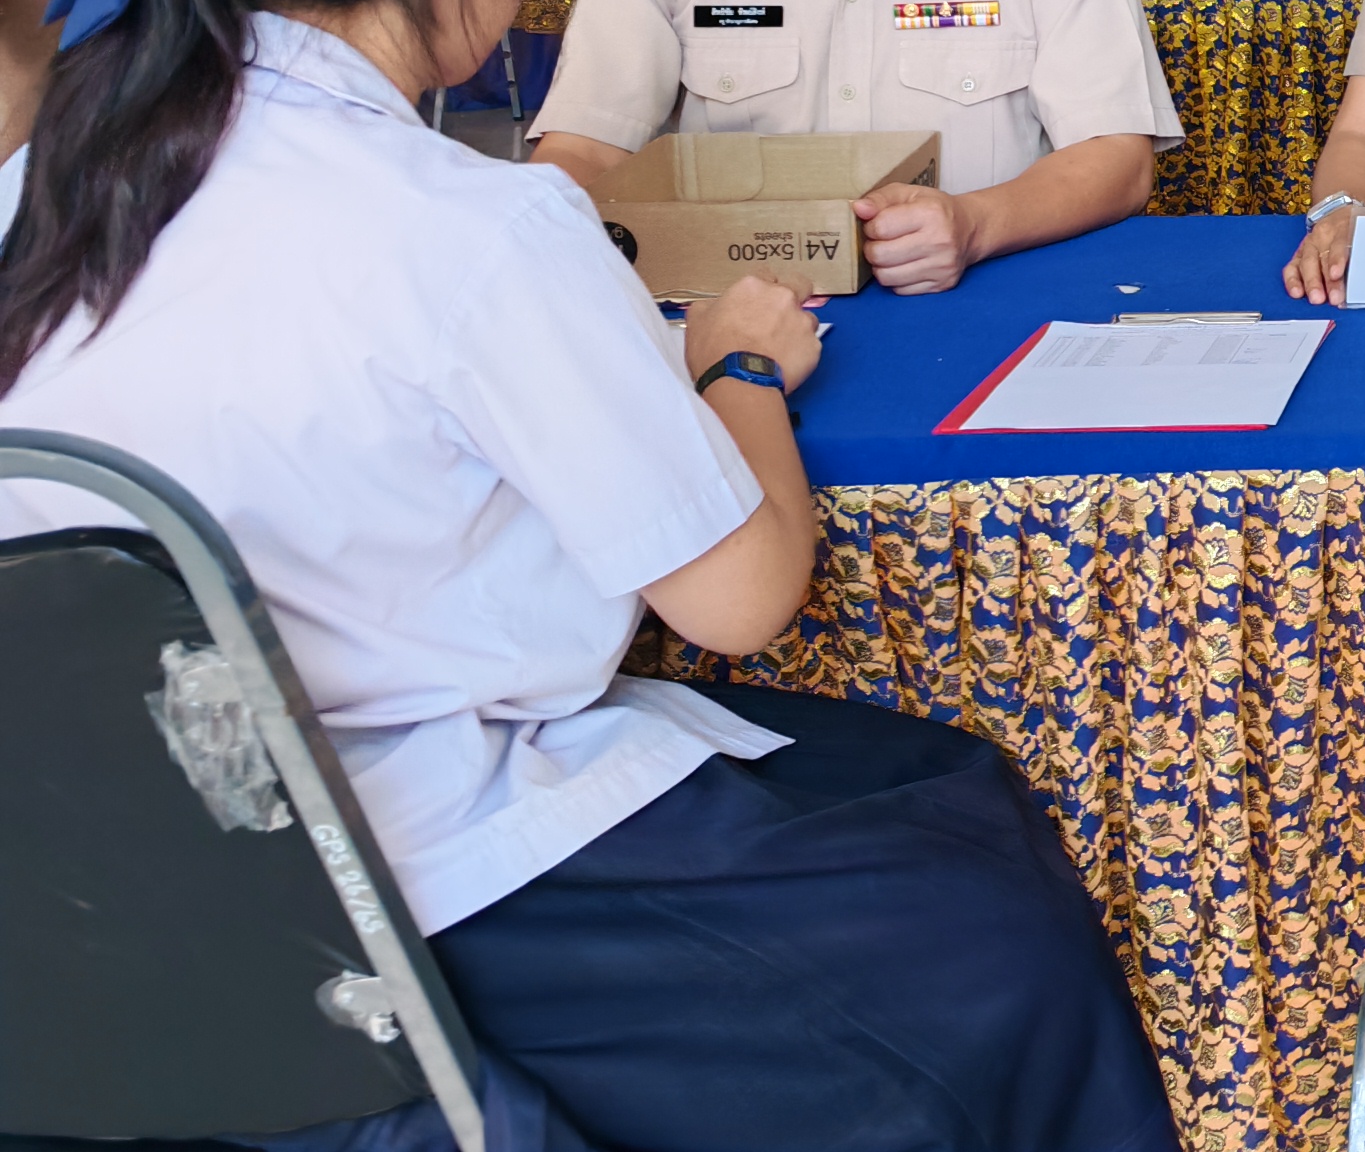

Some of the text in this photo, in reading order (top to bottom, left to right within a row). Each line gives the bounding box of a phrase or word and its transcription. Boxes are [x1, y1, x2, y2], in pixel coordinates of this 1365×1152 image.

[753, 232, 793, 242] sheets
[728, 239, 840, 262] A4 5x500
